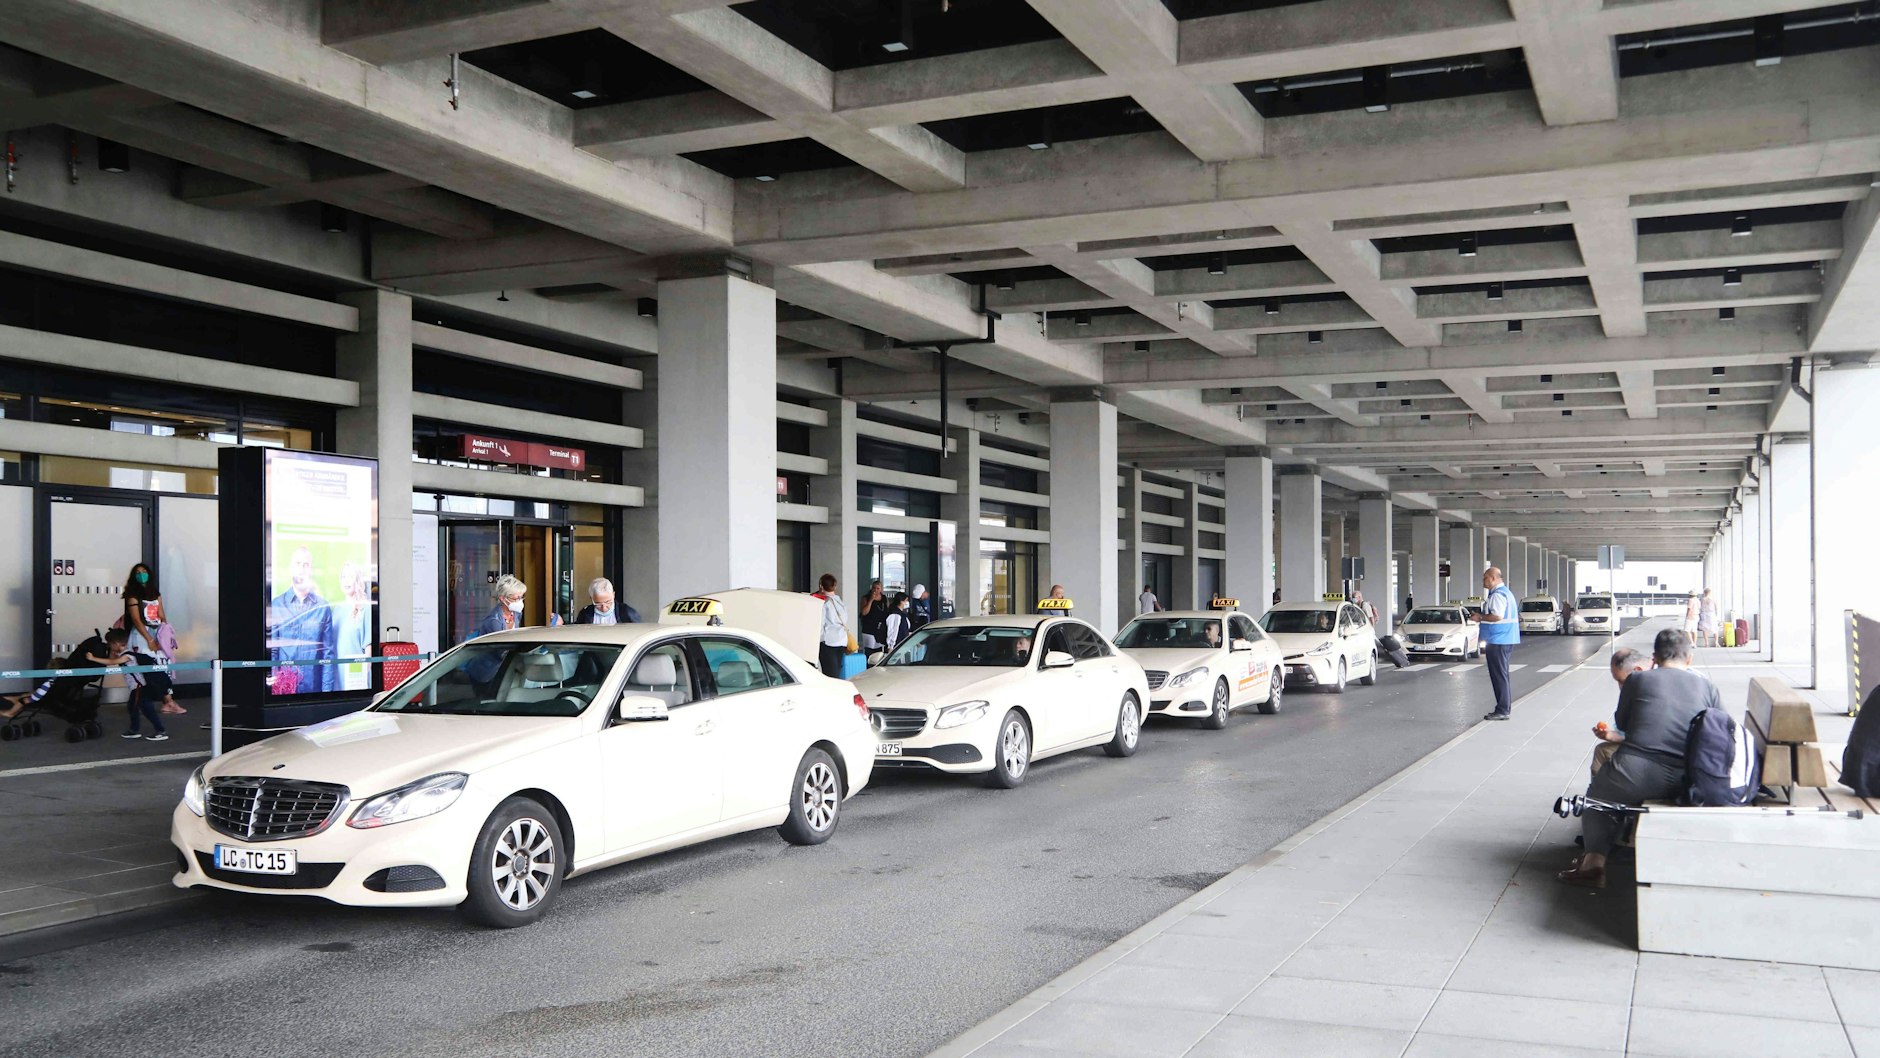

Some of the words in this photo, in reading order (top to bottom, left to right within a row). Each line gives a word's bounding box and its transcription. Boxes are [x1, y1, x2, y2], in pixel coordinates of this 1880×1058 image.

[472, 439, 494, 448] Ankunft
[549, 449, 569, 458] Terminal
[571, 455, 579, 464] T1
[674, 602, 706, 612] TAXI
[882, 744, 900, 754] 875
[224, 850, 238, 866] LC
[246, 852, 264, 868] TC
[268, 854, 286, 870] 15
